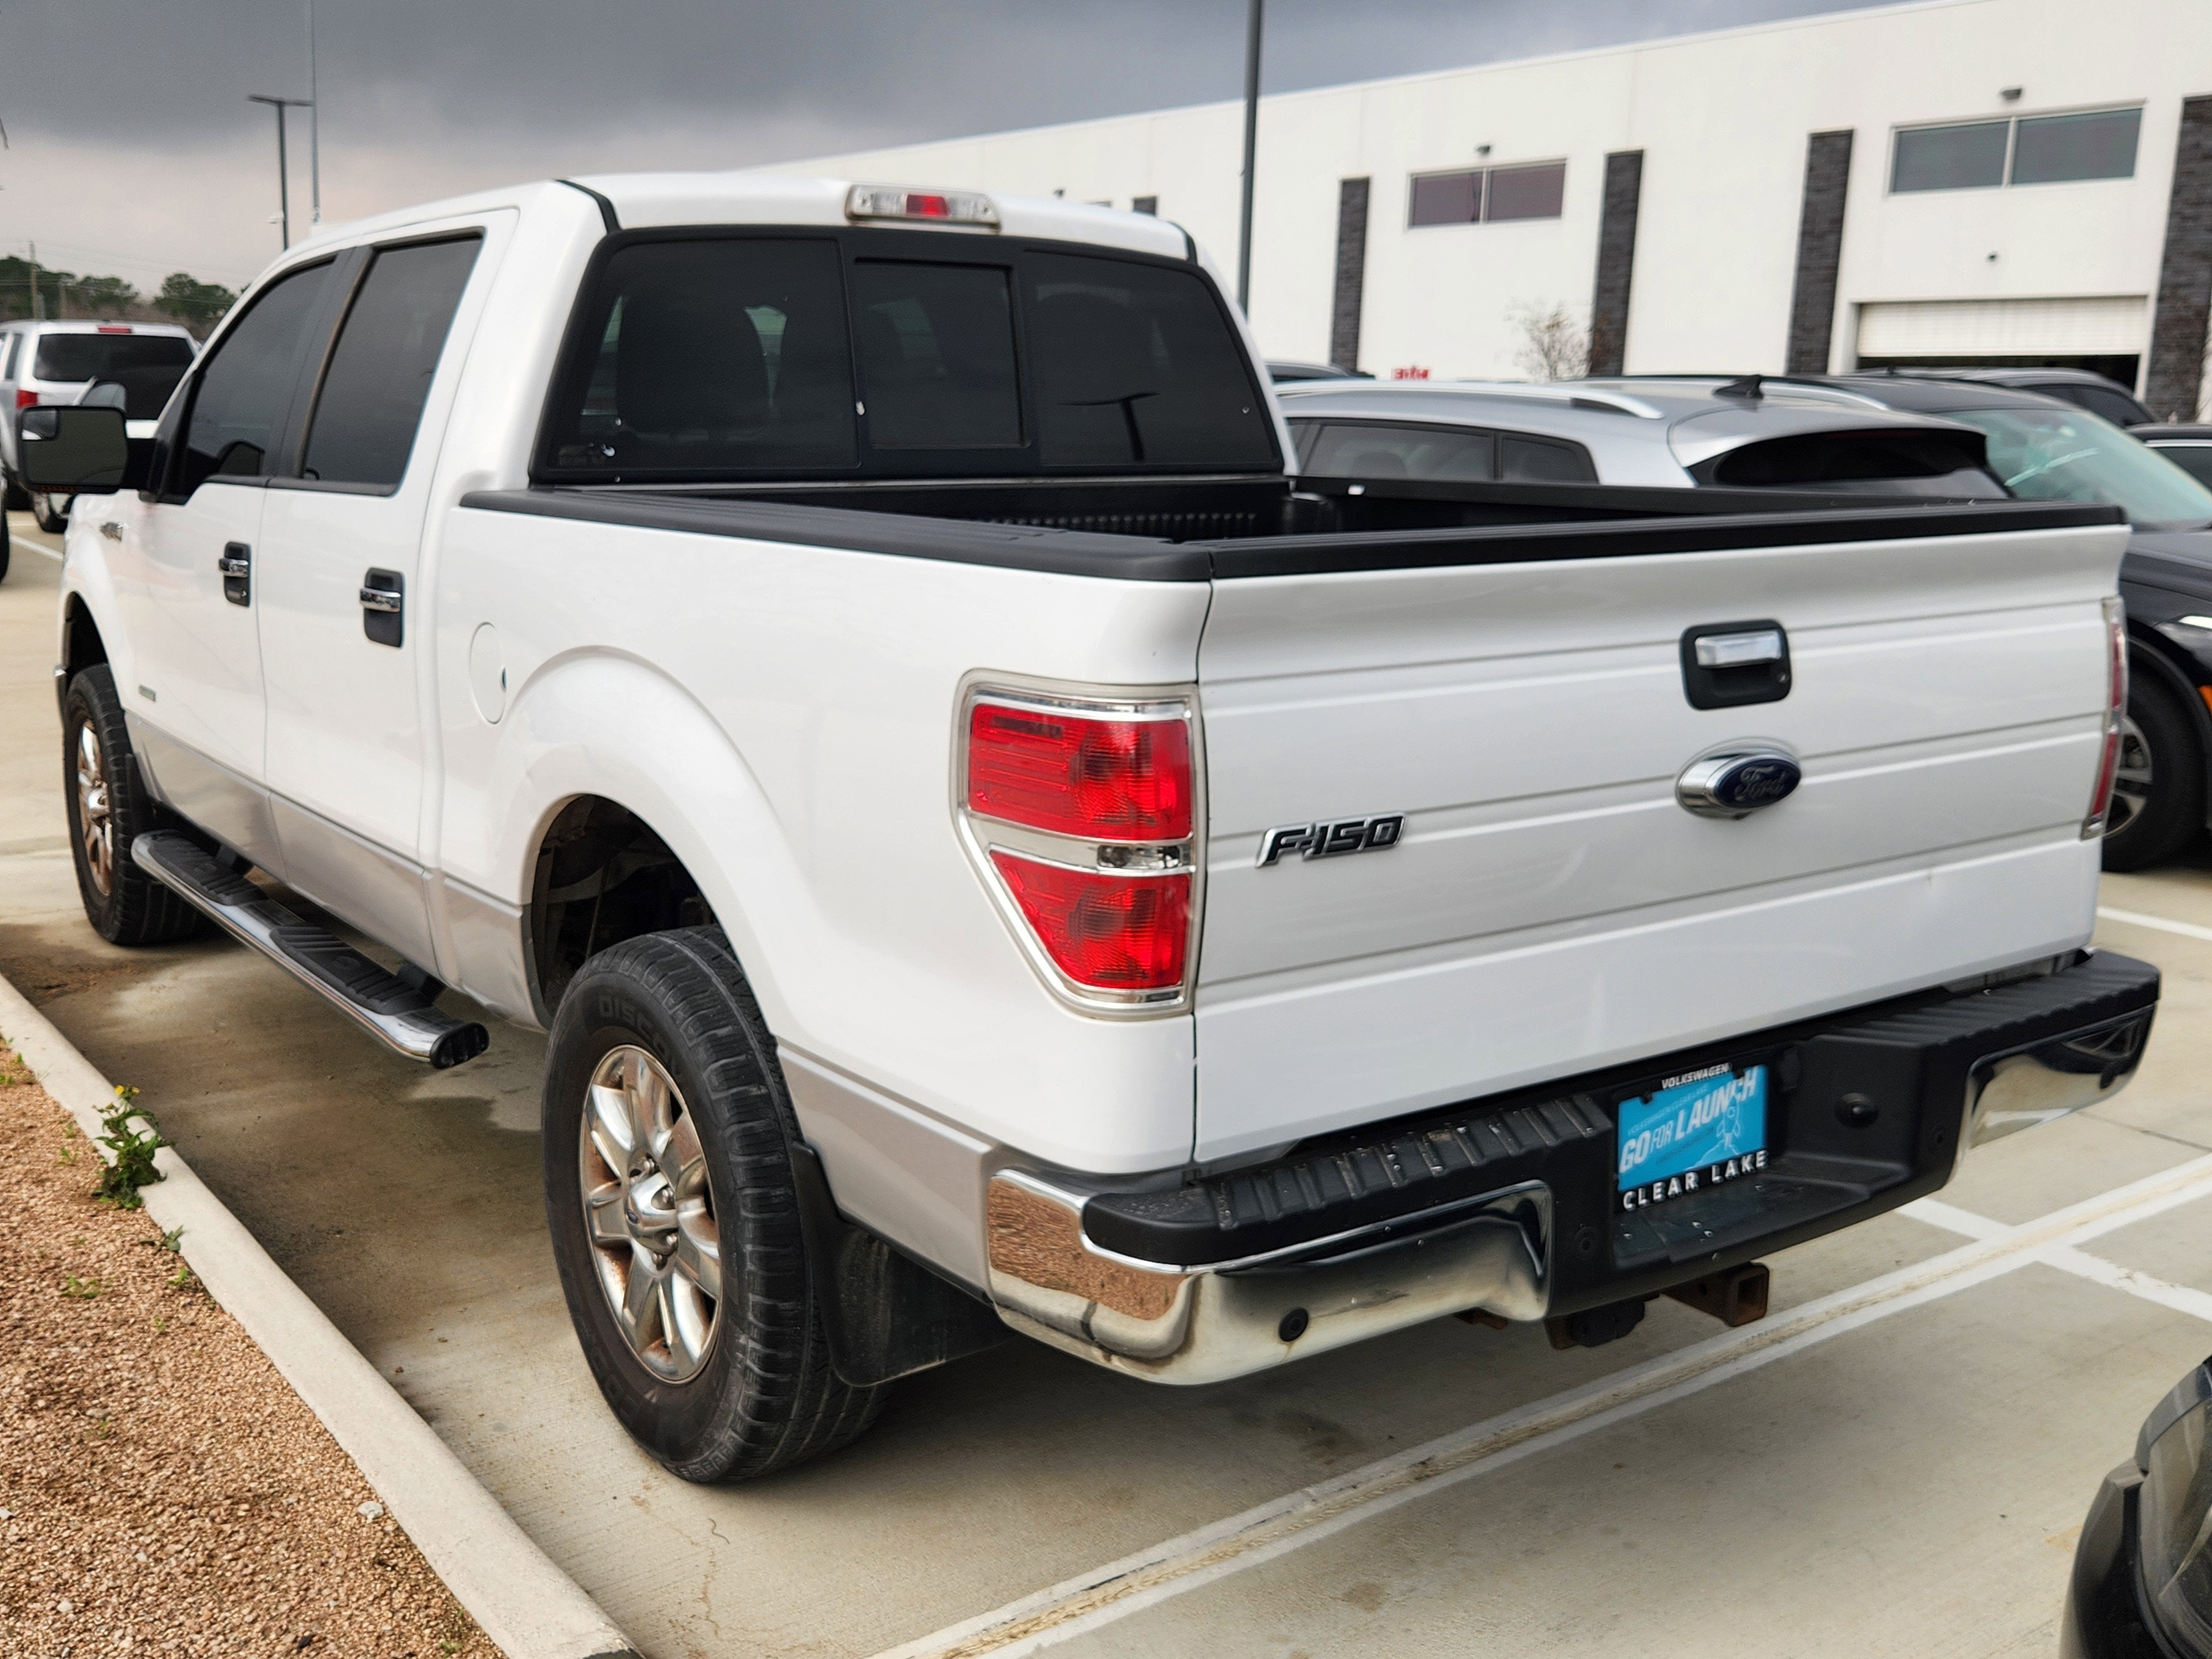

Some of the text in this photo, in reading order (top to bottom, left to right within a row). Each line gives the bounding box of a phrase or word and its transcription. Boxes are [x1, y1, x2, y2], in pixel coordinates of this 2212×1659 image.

[1255, 812, 1407, 868] F-150
[1661, 1062, 1731, 1089] VOLKSWAGEN
[1619, 1129, 1651, 1173] GO
[1650, 1120, 1673, 1154] FOR
[1674, 1066, 1759, 1141] LAUNCH
[1623, 1150, 1769, 1211] CLEAR LAKE
